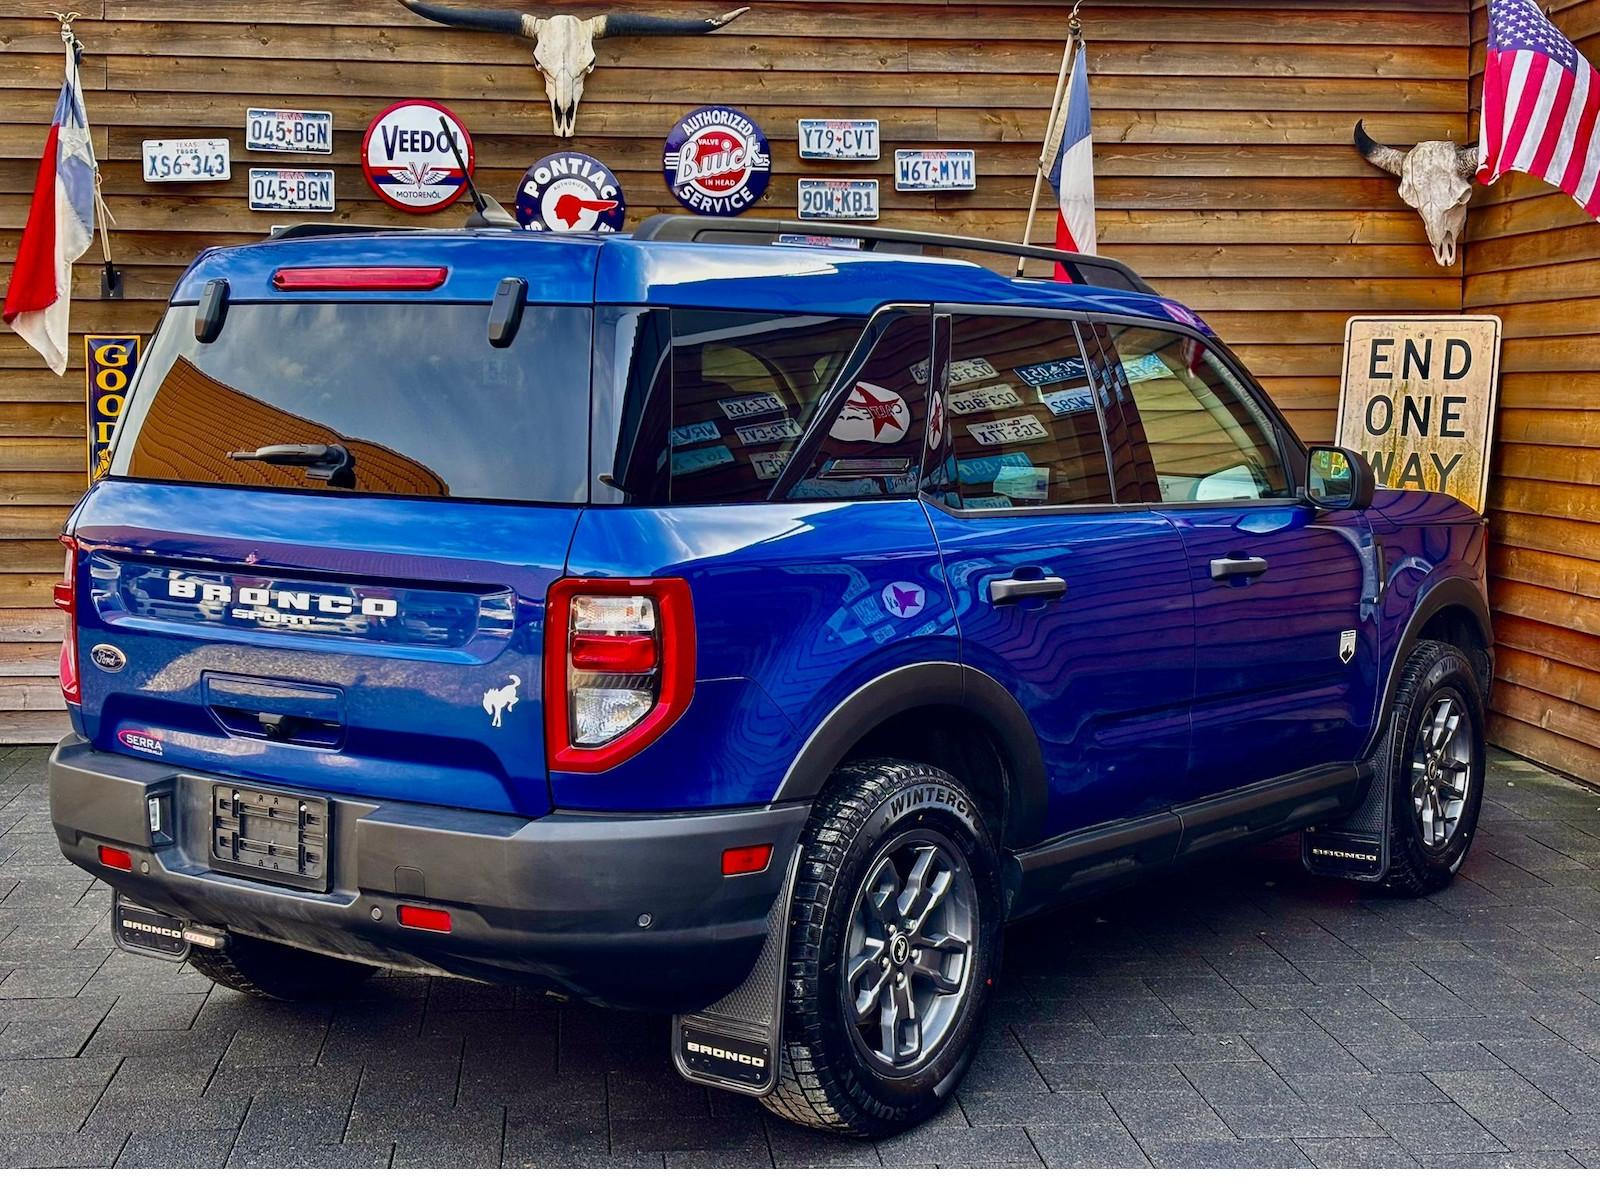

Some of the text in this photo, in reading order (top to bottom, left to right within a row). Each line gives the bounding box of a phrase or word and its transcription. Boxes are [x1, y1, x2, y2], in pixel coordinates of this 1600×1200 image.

[294, 121, 328, 144] BGN
[681, 109, 754, 137] AUTHORIZED
[381, 124, 463, 161] VEEDOL
[697, 138, 720, 146] VALVE
[803, 129, 875, 150] Y79 CVT
[191, 153, 225, 175] 343
[674, 134, 763, 186] Buick
[296, 180, 330, 202] BGN
[523, 157, 618, 200] PONTIAC
[679, 185, 754, 213] SERVICE
[1368, 338, 1473, 381] END
[1365, 394, 1467, 438] ONE
[1361, 450, 1464, 492] WAY
[168, 579, 398, 617] BRONCO
[231, 608, 317, 625] SPORT
[95, 648, 118, 668] Ford
[126, 733, 163, 751] SERRA
[1312, 848, 1377, 861] BRONCO
[122, 919, 182, 939] BRONCO
[687, 1041, 765, 1068] BRONCO
